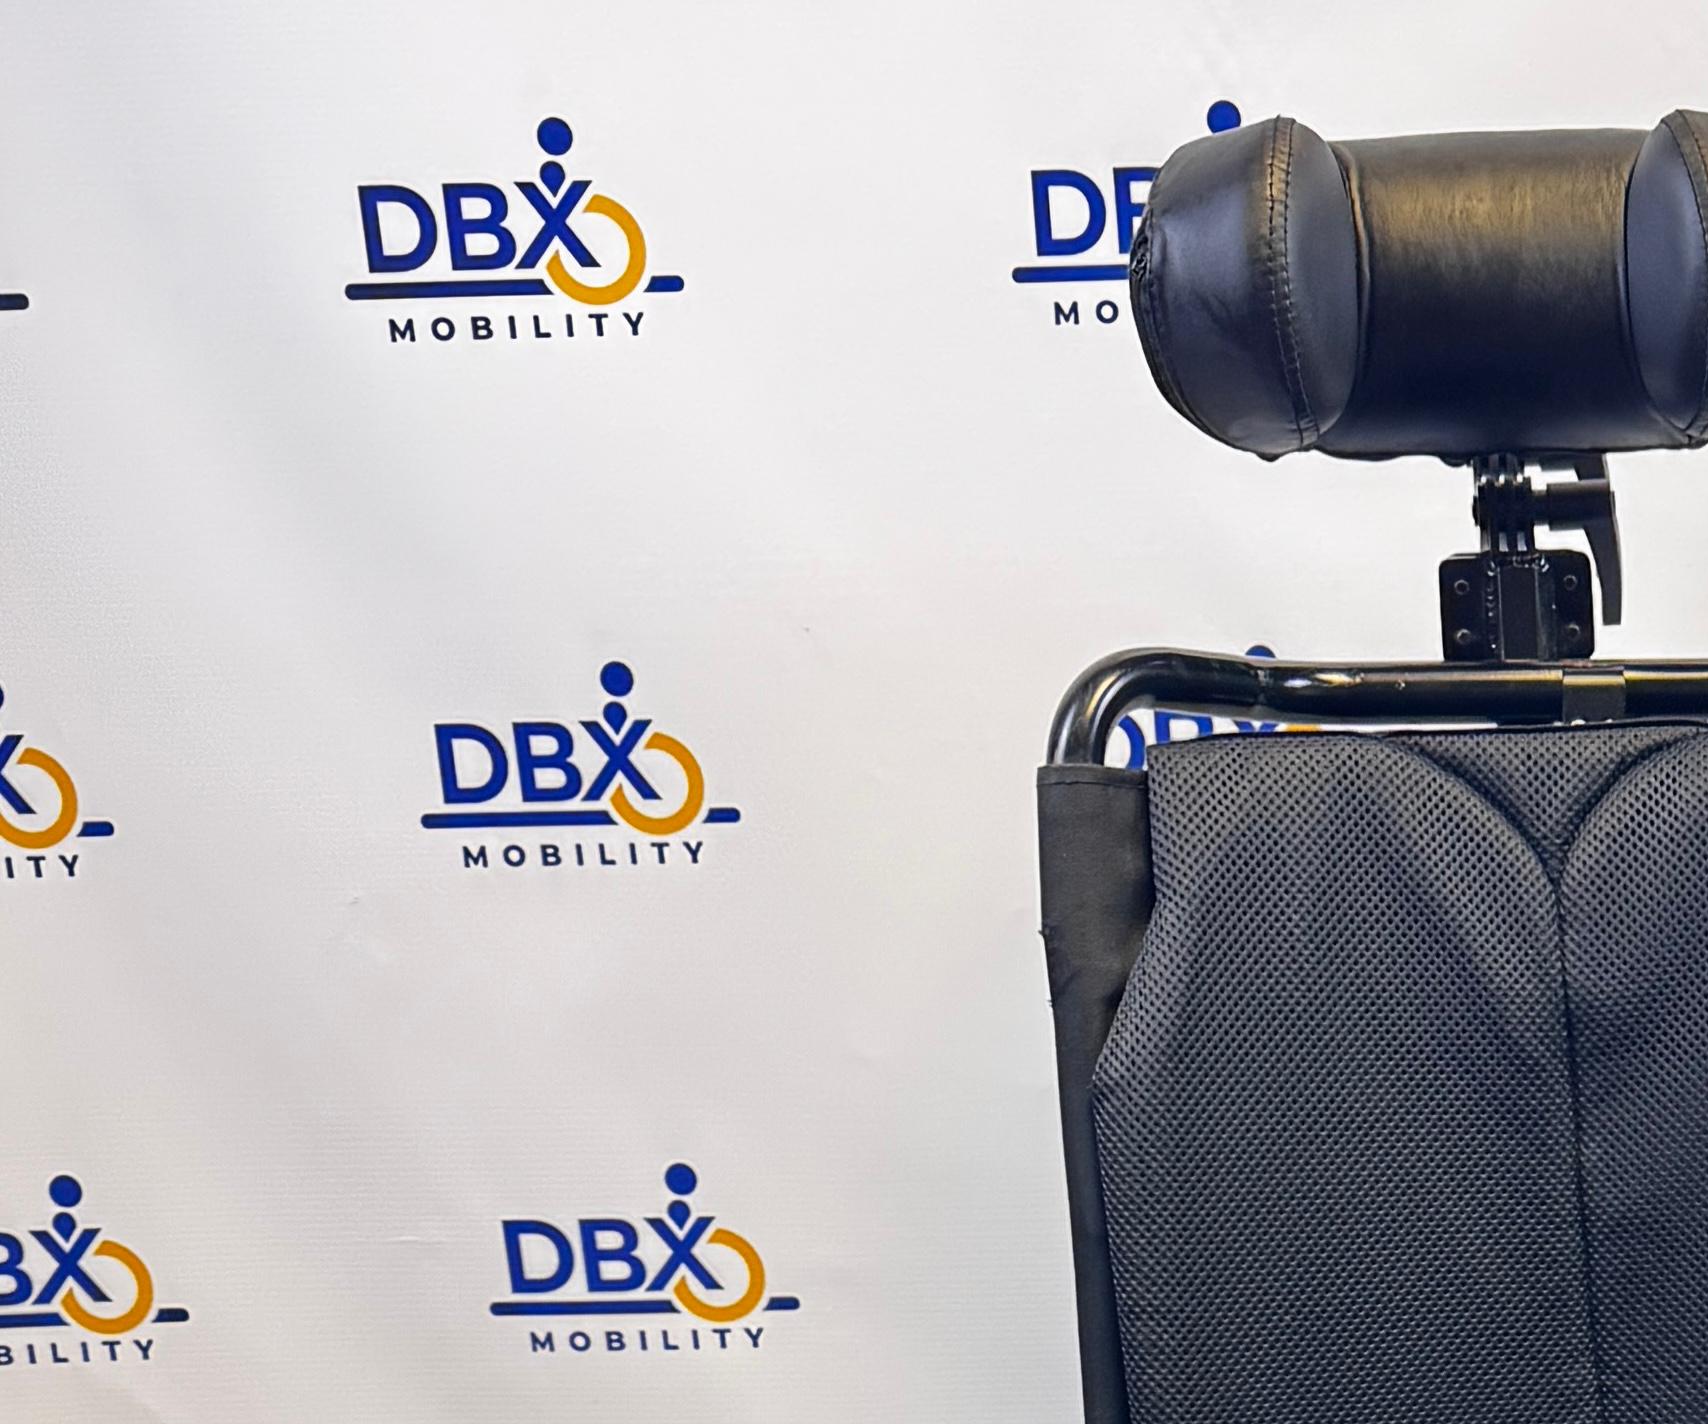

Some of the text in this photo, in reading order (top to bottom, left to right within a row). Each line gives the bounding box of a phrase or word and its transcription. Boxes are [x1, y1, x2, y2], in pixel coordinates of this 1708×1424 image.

[357, 179, 602, 274] DBX
[388, 311, 644, 343] MOBILITY
[433, 718, 663, 805] DBX
[462, 841, 703, 869] MOBILITY
[501, 1216, 724, 1294] DBX
[0, 1339, 154, 1366] BILITY
[529, 1327, 764, 1353] MOBILITY
